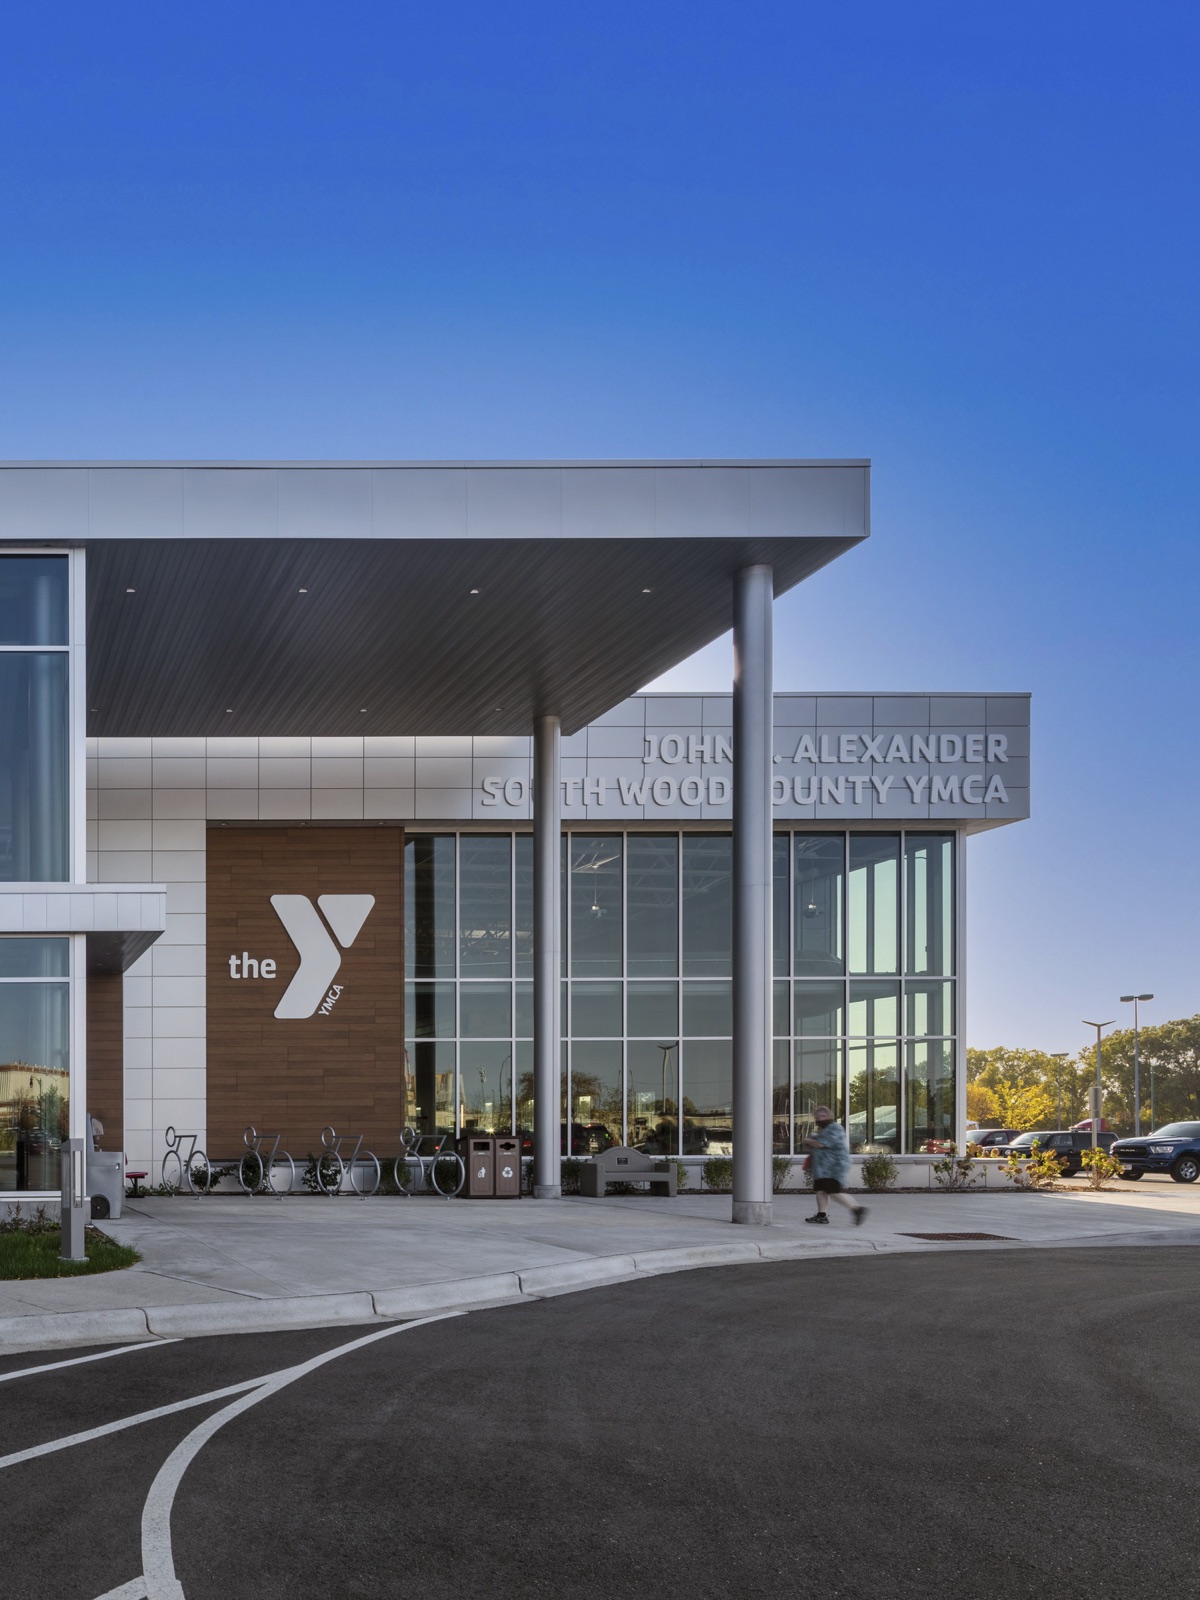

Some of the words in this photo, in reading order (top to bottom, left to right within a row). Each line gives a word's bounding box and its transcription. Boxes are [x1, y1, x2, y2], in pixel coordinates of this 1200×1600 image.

[793, 734, 1009, 764] ALEXANDER
[481, 776, 606, 807] SOTH
[617, 775, 732, 806] WOOD
[773, 774, 895, 806] OUNTY
[905, 774, 1010, 805] YMCA
[228, 951, 277, 980] the
[318, 984, 344, 1016] YMCA
